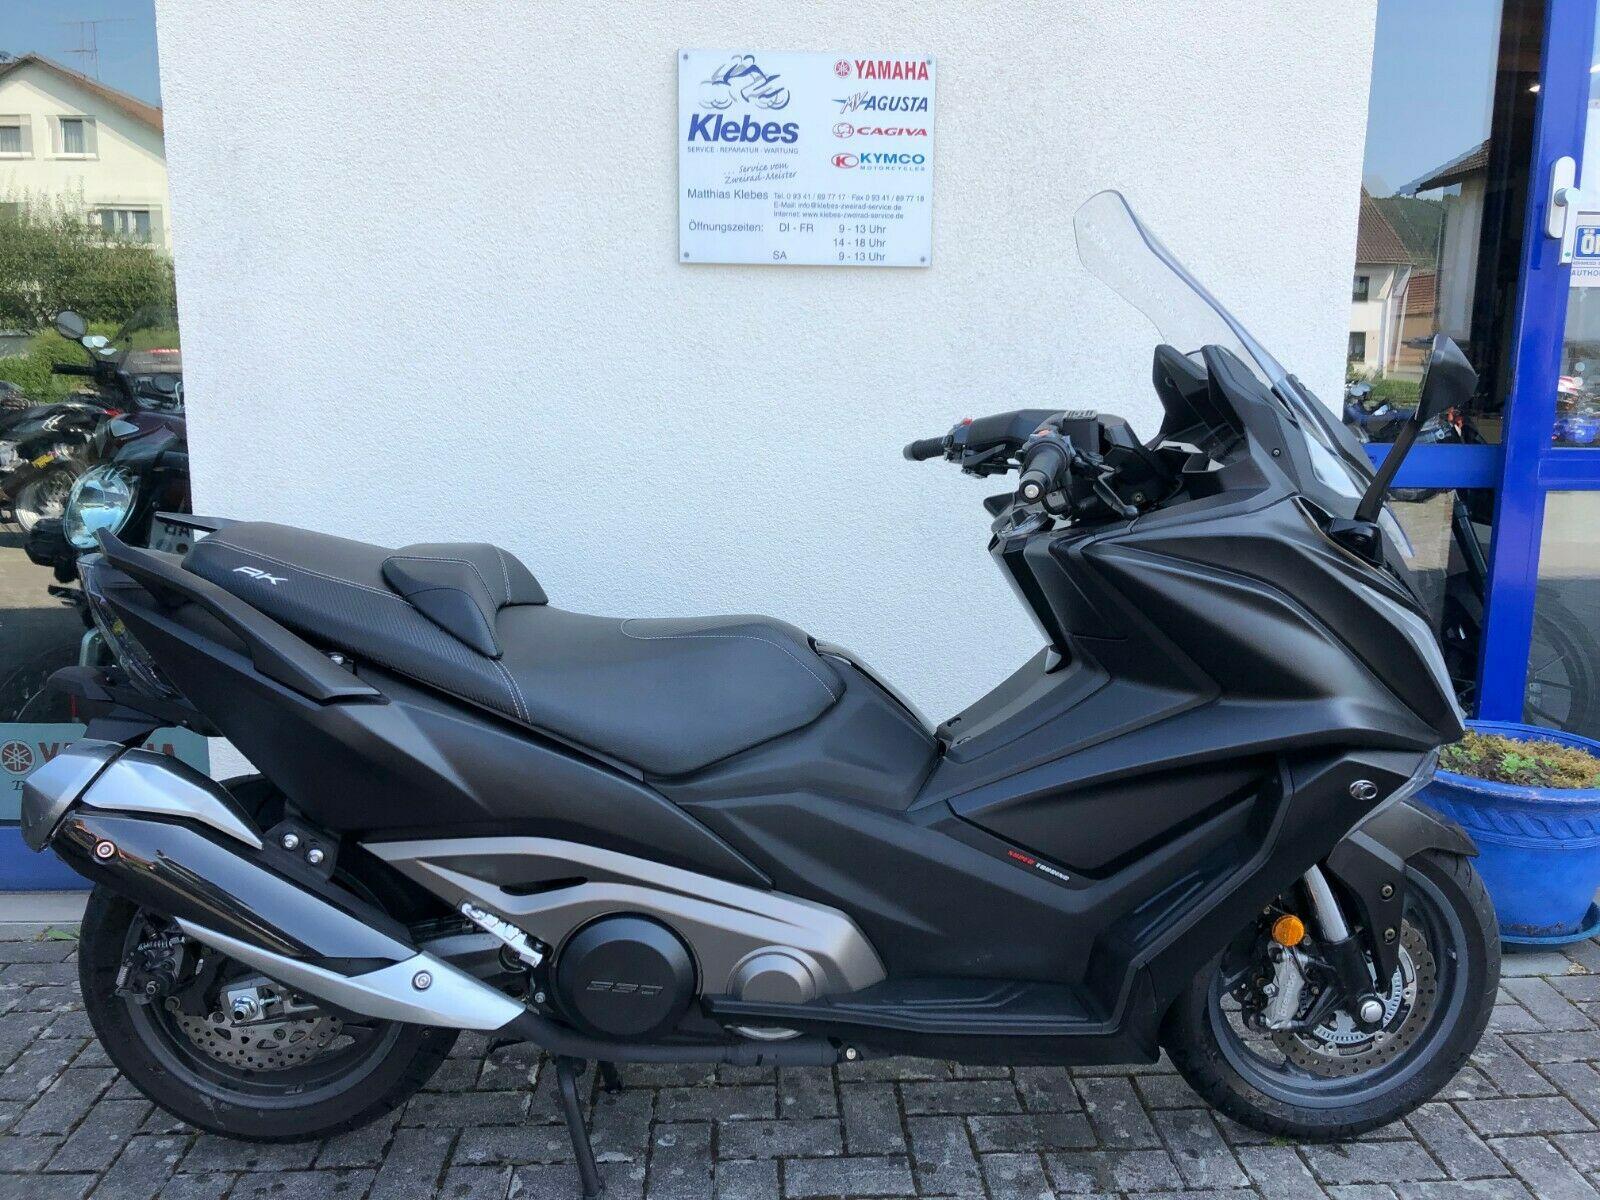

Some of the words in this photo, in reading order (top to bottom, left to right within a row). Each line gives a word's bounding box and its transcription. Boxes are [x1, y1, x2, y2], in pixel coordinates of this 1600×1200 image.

[855, 60, 929, 80] YAMAHA
[864, 95, 928, 112] AGUSTA
[688, 113, 800, 143] Klebes
[857, 127, 928, 136] CAGIVA
[860, 153, 925, 164] KYMCO
[739, 163, 768, 173] Service
[687, 188, 731, 199] Matthias
[734, 189, 768, 200] Klebes
[689, 219, 764, 233] Öffnungszeiten:
[800, 223, 814, 233] FR
[839, 225, 845, 233] 9
[855, 225, 866, 233] 13
[869, 225, 886, 234] Uhr
[834, 239, 844, 247] 14
[855, 239, 866, 247] 18
[869, 239, 886, 248] Uhr
[772, 250, 787, 260] SA
[839, 252, 845, 261] 9
[855, 252, 866, 261] 13
[869, 252, 886, 261] Uhr
